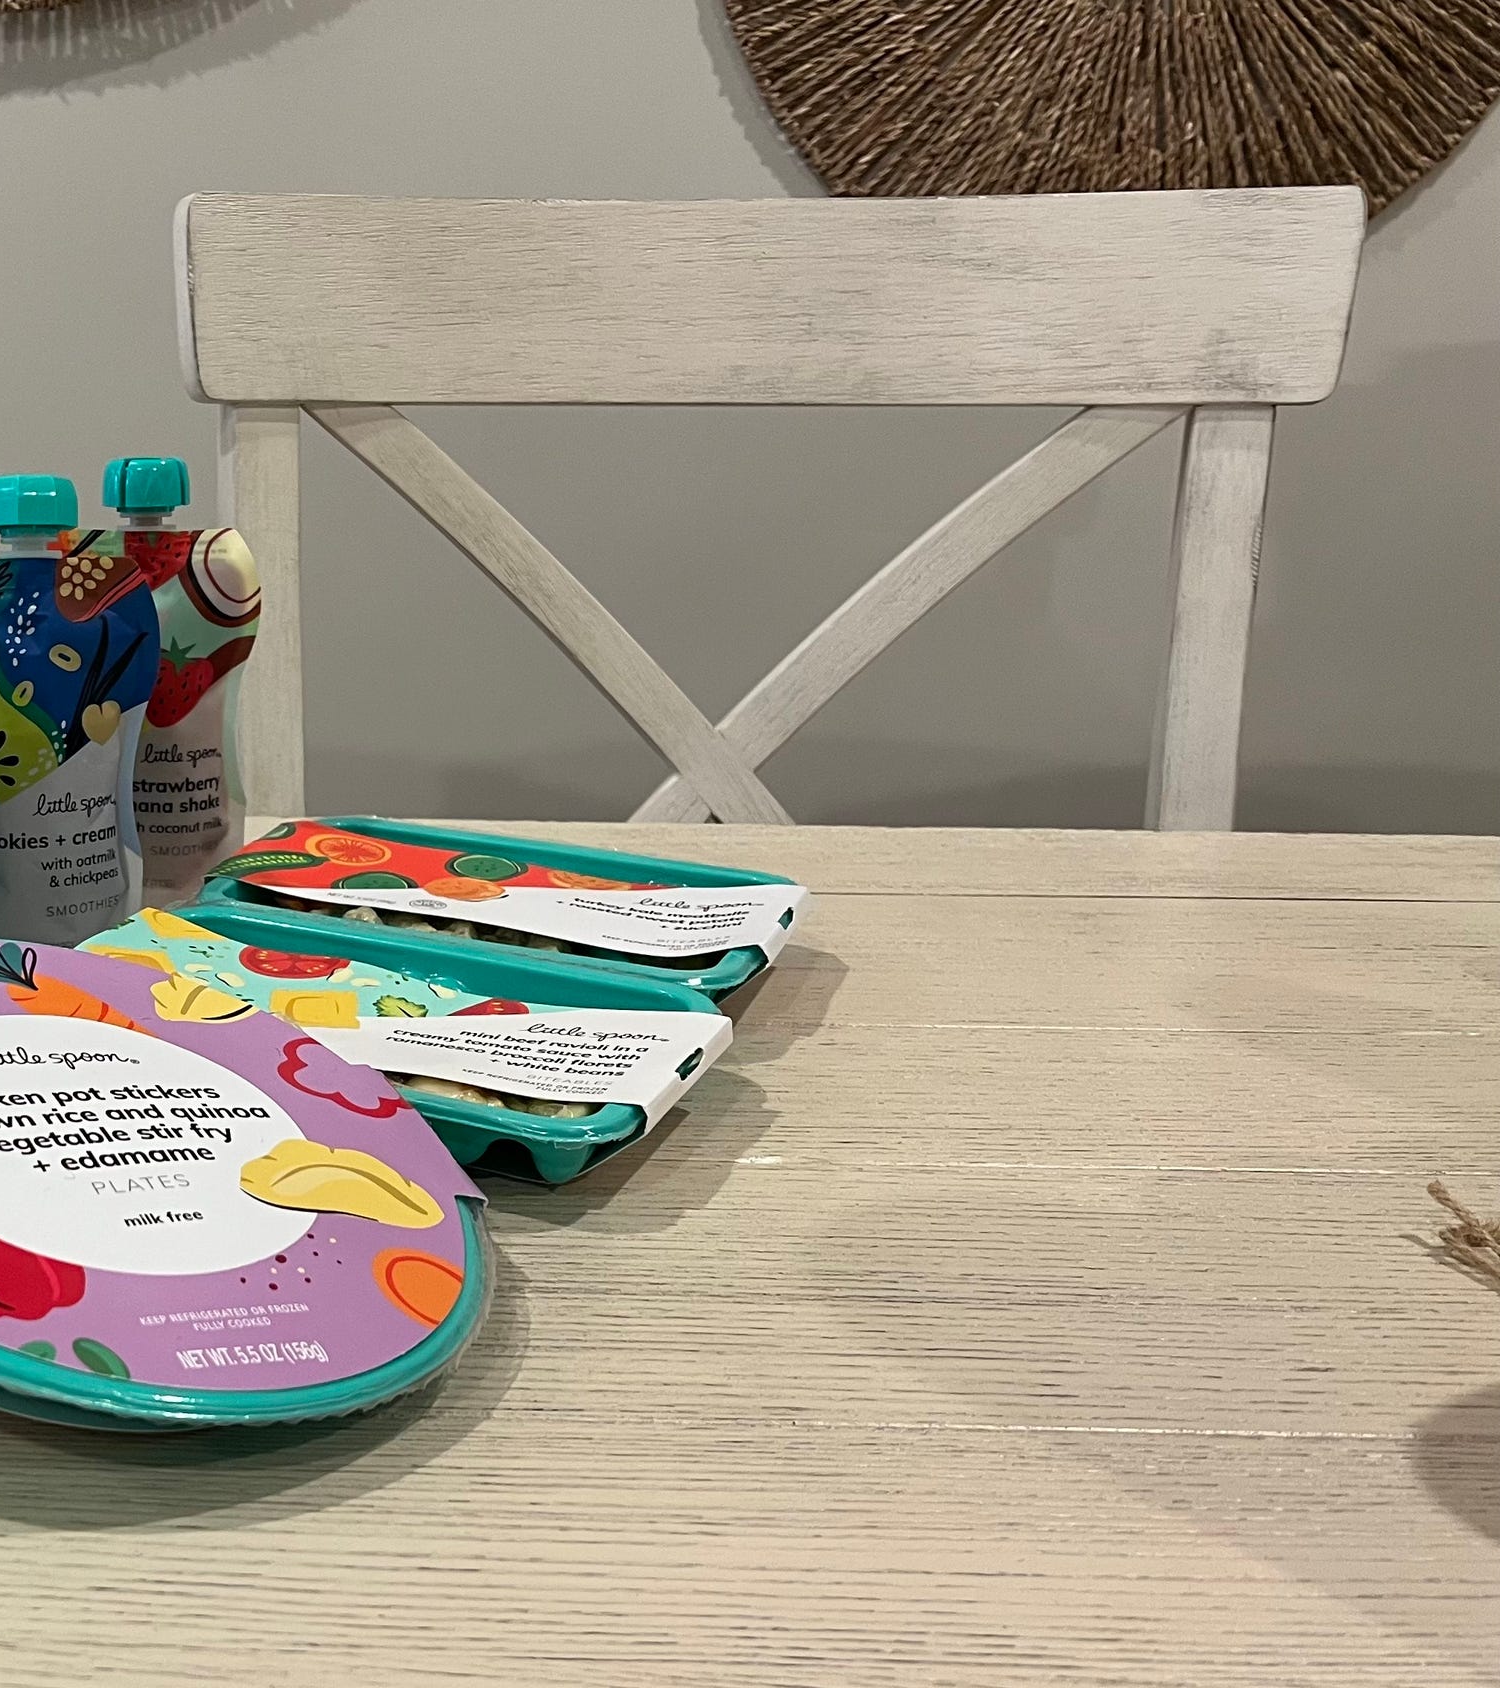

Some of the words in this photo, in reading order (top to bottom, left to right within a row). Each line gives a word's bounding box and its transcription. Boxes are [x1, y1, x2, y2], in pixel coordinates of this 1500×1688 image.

[140, 743, 183, 764] little
[32, 792, 78, 816] little
[55, 834, 66, 846] +
[72, 825, 116, 846] cream
[149, 822, 200, 834] coconut
[41, 857, 72, 871] with
[76, 848, 116, 868] oatmilk
[49, 875, 60, 888] &
[64, 866, 119, 888] chickpeas
[46, 895, 119, 918] SMOOTHIES
[569, 902, 632, 917] roasted
[636, 914, 685, 925] sweet
[688, 915, 746, 926] potato
[574, 897, 626, 910] turkey
[629, 906, 663, 916] kale
[667, 909, 750, 919] meatballs
[633, 897, 691, 909] little
[673, 921, 742, 931] zucchini
[459, 1030, 501, 1042] mini
[503, 1034, 546, 1046] beef
[549, 1041, 610, 1052] ravioli
[518, 1023, 586, 1037] little
[385, 1035, 486, 1055] romanesco
[490, 1050, 566, 1066] broccoli
[570, 1058, 633, 1070] florets
[393, 1029, 460, 1044] creamy
[464, 1038, 532, 1053] tomato
[535, 1047, 592, 1059] sauce
[597, 1053, 641, 1062] with
[506, 1062, 560, 1073] white
[564, 1068, 626, 1078] beans
[52, 1086, 106, 1107] pot
[110, 1084, 221, 1100] stickers
[42, 1108, 100, 1124] rice
[105, 1104, 165, 1120] and
[170, 1103, 271, 1122] quinoa
[136, 1123, 186, 1140] stir
[190, 1123, 233, 1144] fry
[33, 1159, 51, 1172] +
[60, 1145, 216, 1171] edamame
[91, 1173, 190, 1195] PLATES
[124, 1212, 164, 1227] milk
[166, 1210, 204, 1223] free
[139, 1314, 166, 1327] KEEP
[169, 1306, 249, 1323] REFRIGERATED
[251, 1304, 266, 1315] OR
[268, 1302, 310, 1315] FROZEN
[193, 1319, 226, 1332] FULLY
[228, 1316, 272, 1329] COOKED
[176, 1349, 210, 1370] NET
[206, 1347, 238, 1368] WT.
[234, 1345, 263, 1365] 5.5
[258, 1343, 286, 1363] OZ
[280, 1340, 330, 1365] (156g)
